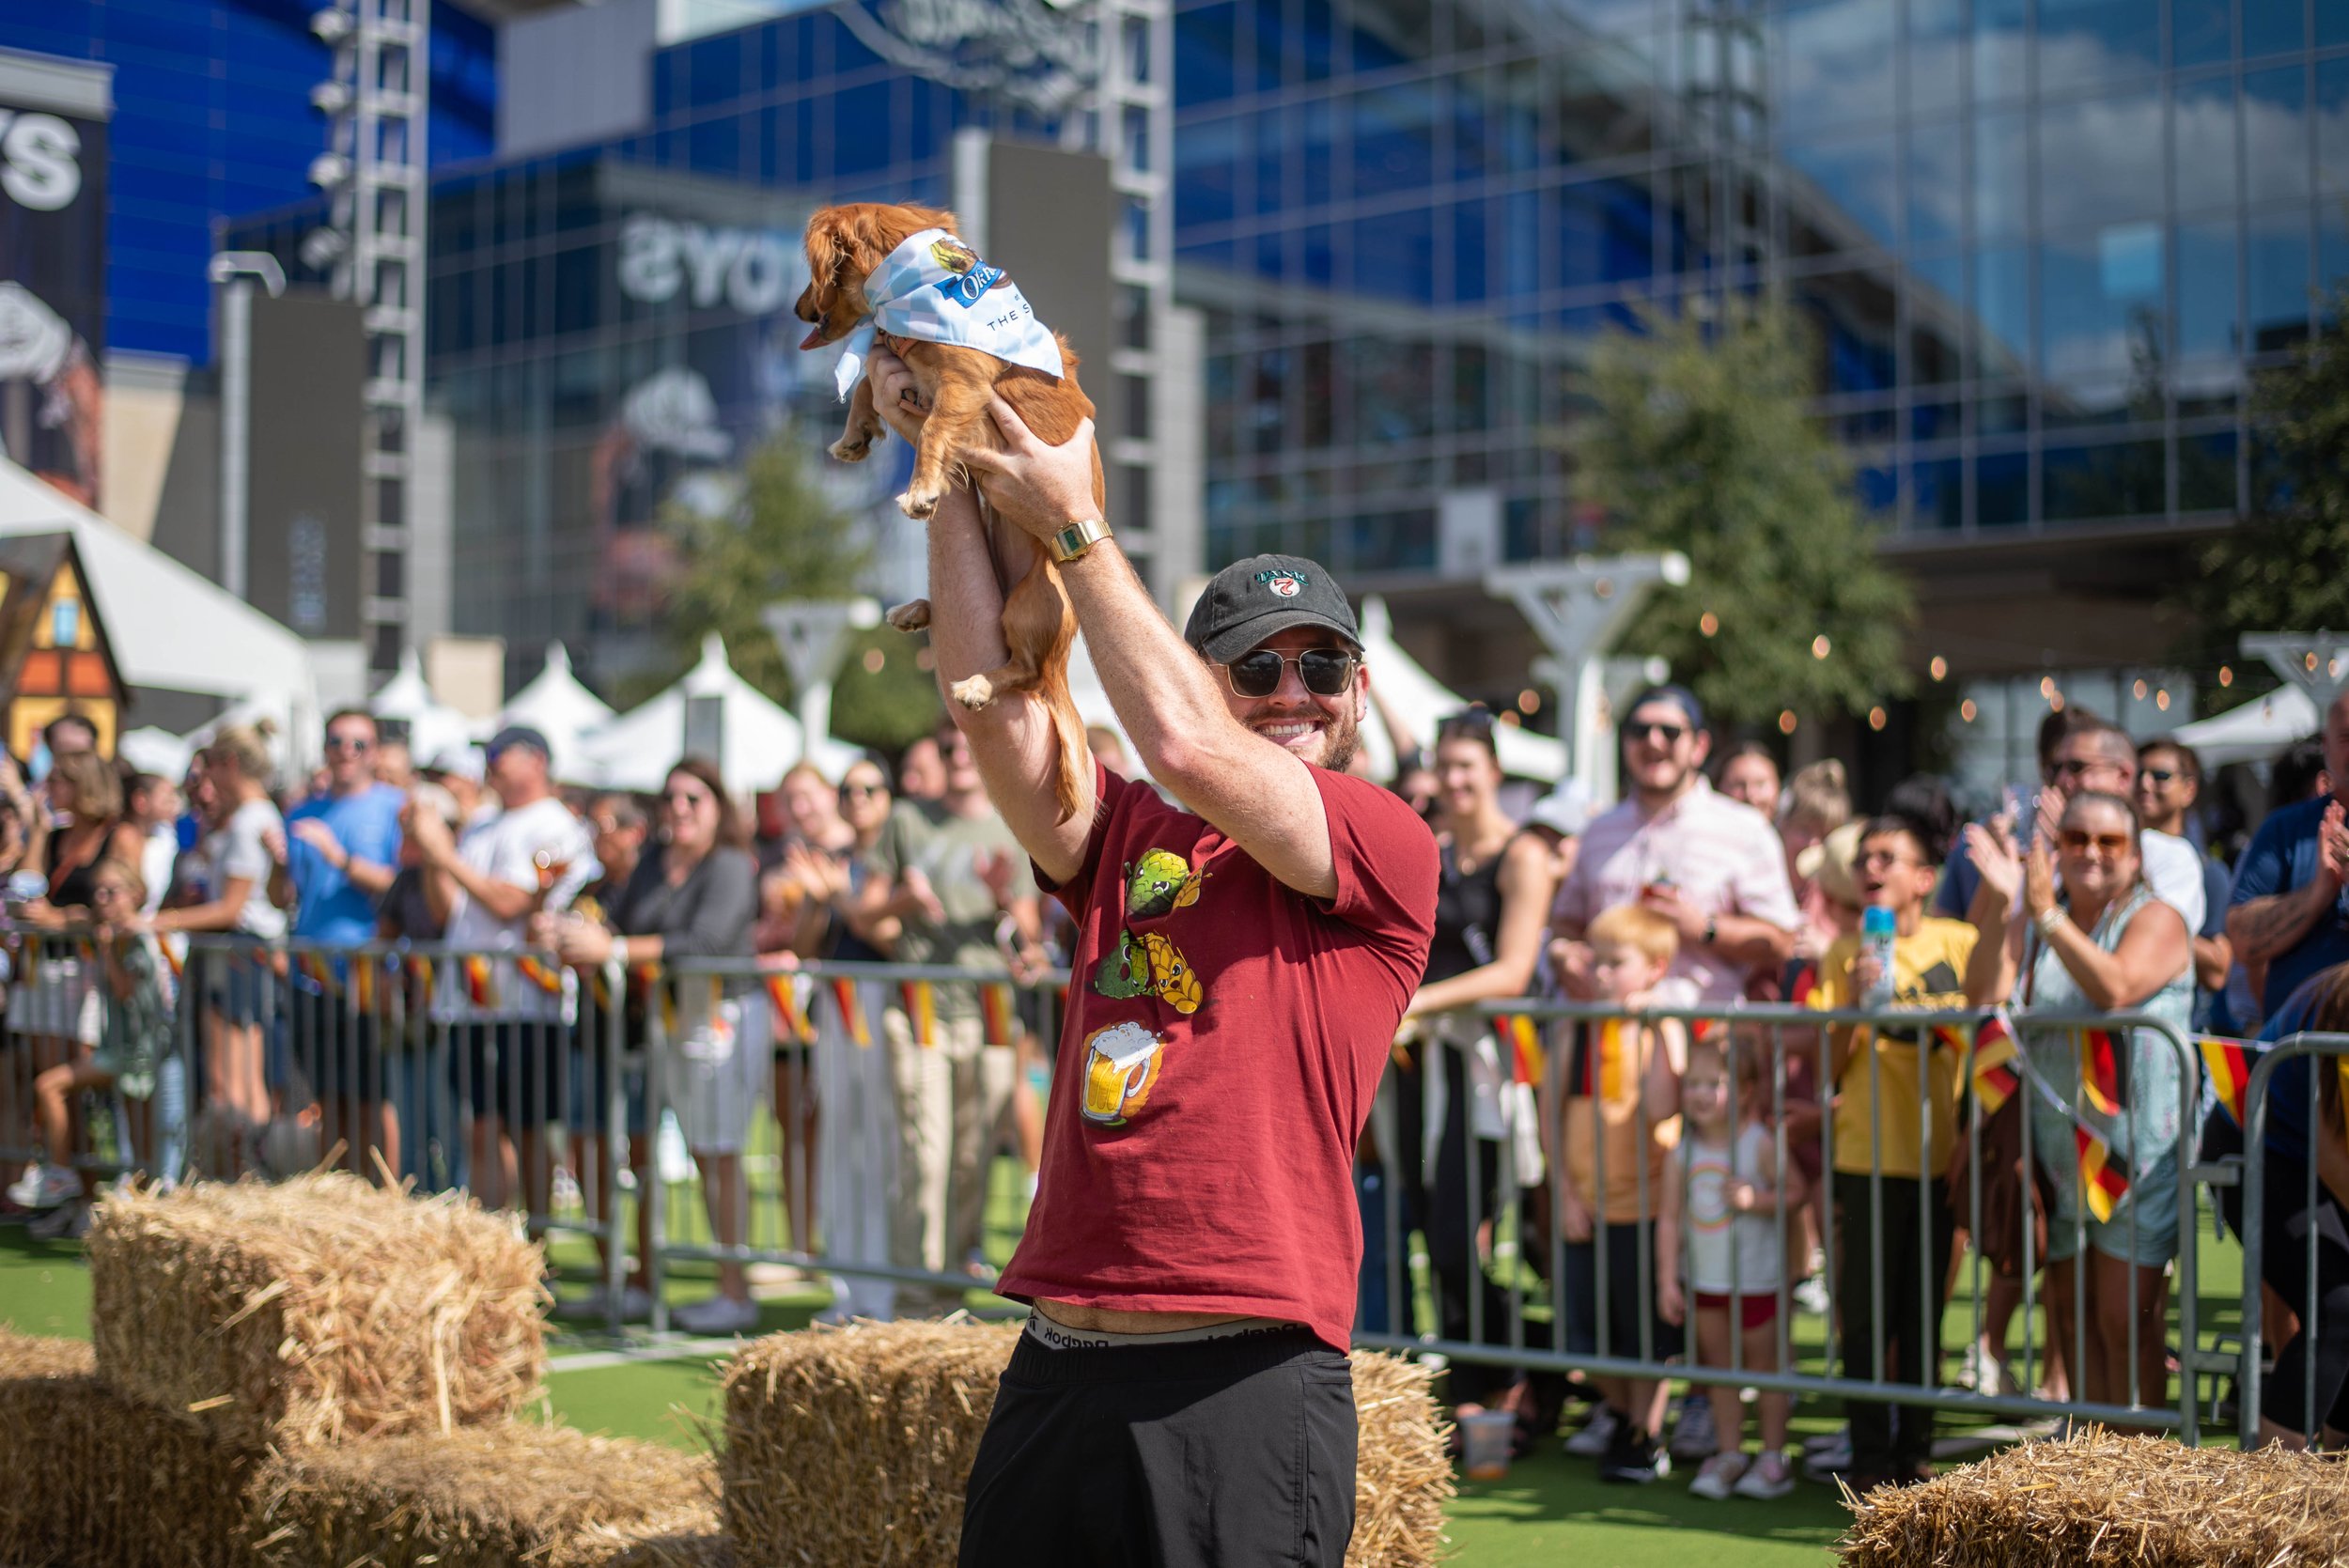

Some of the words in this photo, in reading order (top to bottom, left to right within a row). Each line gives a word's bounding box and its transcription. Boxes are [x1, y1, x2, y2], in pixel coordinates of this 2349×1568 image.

[0, 109, 83, 211] S
[988, 311, 1019, 331] THE
[1022, 303, 1031, 313] S
[1254, 569, 1308, 585] TANK
[1274, 579, 1294, 595] 7
